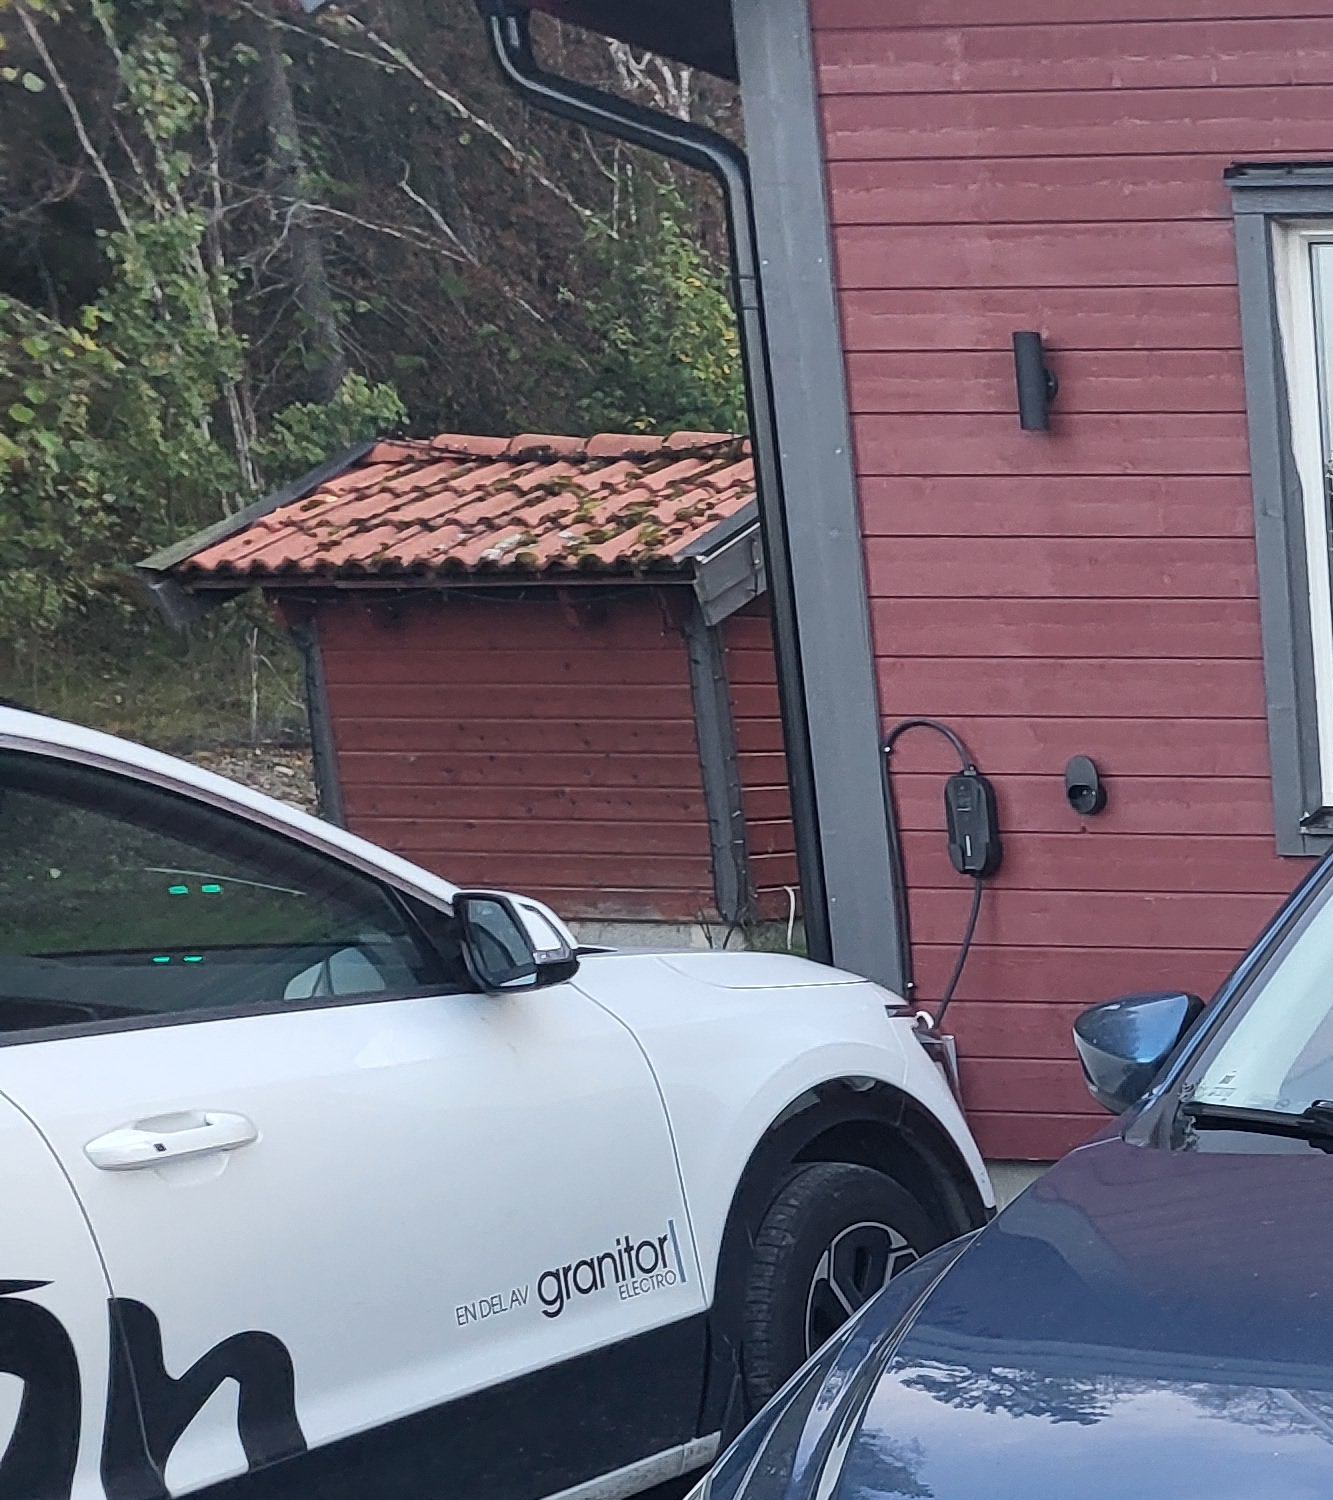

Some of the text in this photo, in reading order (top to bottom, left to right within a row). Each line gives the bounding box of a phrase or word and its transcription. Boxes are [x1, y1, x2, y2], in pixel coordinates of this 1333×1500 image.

[456, 1235, 668, 1325] EN DEL AV granitor
[619, 1270, 676, 1300] ELECTRO
